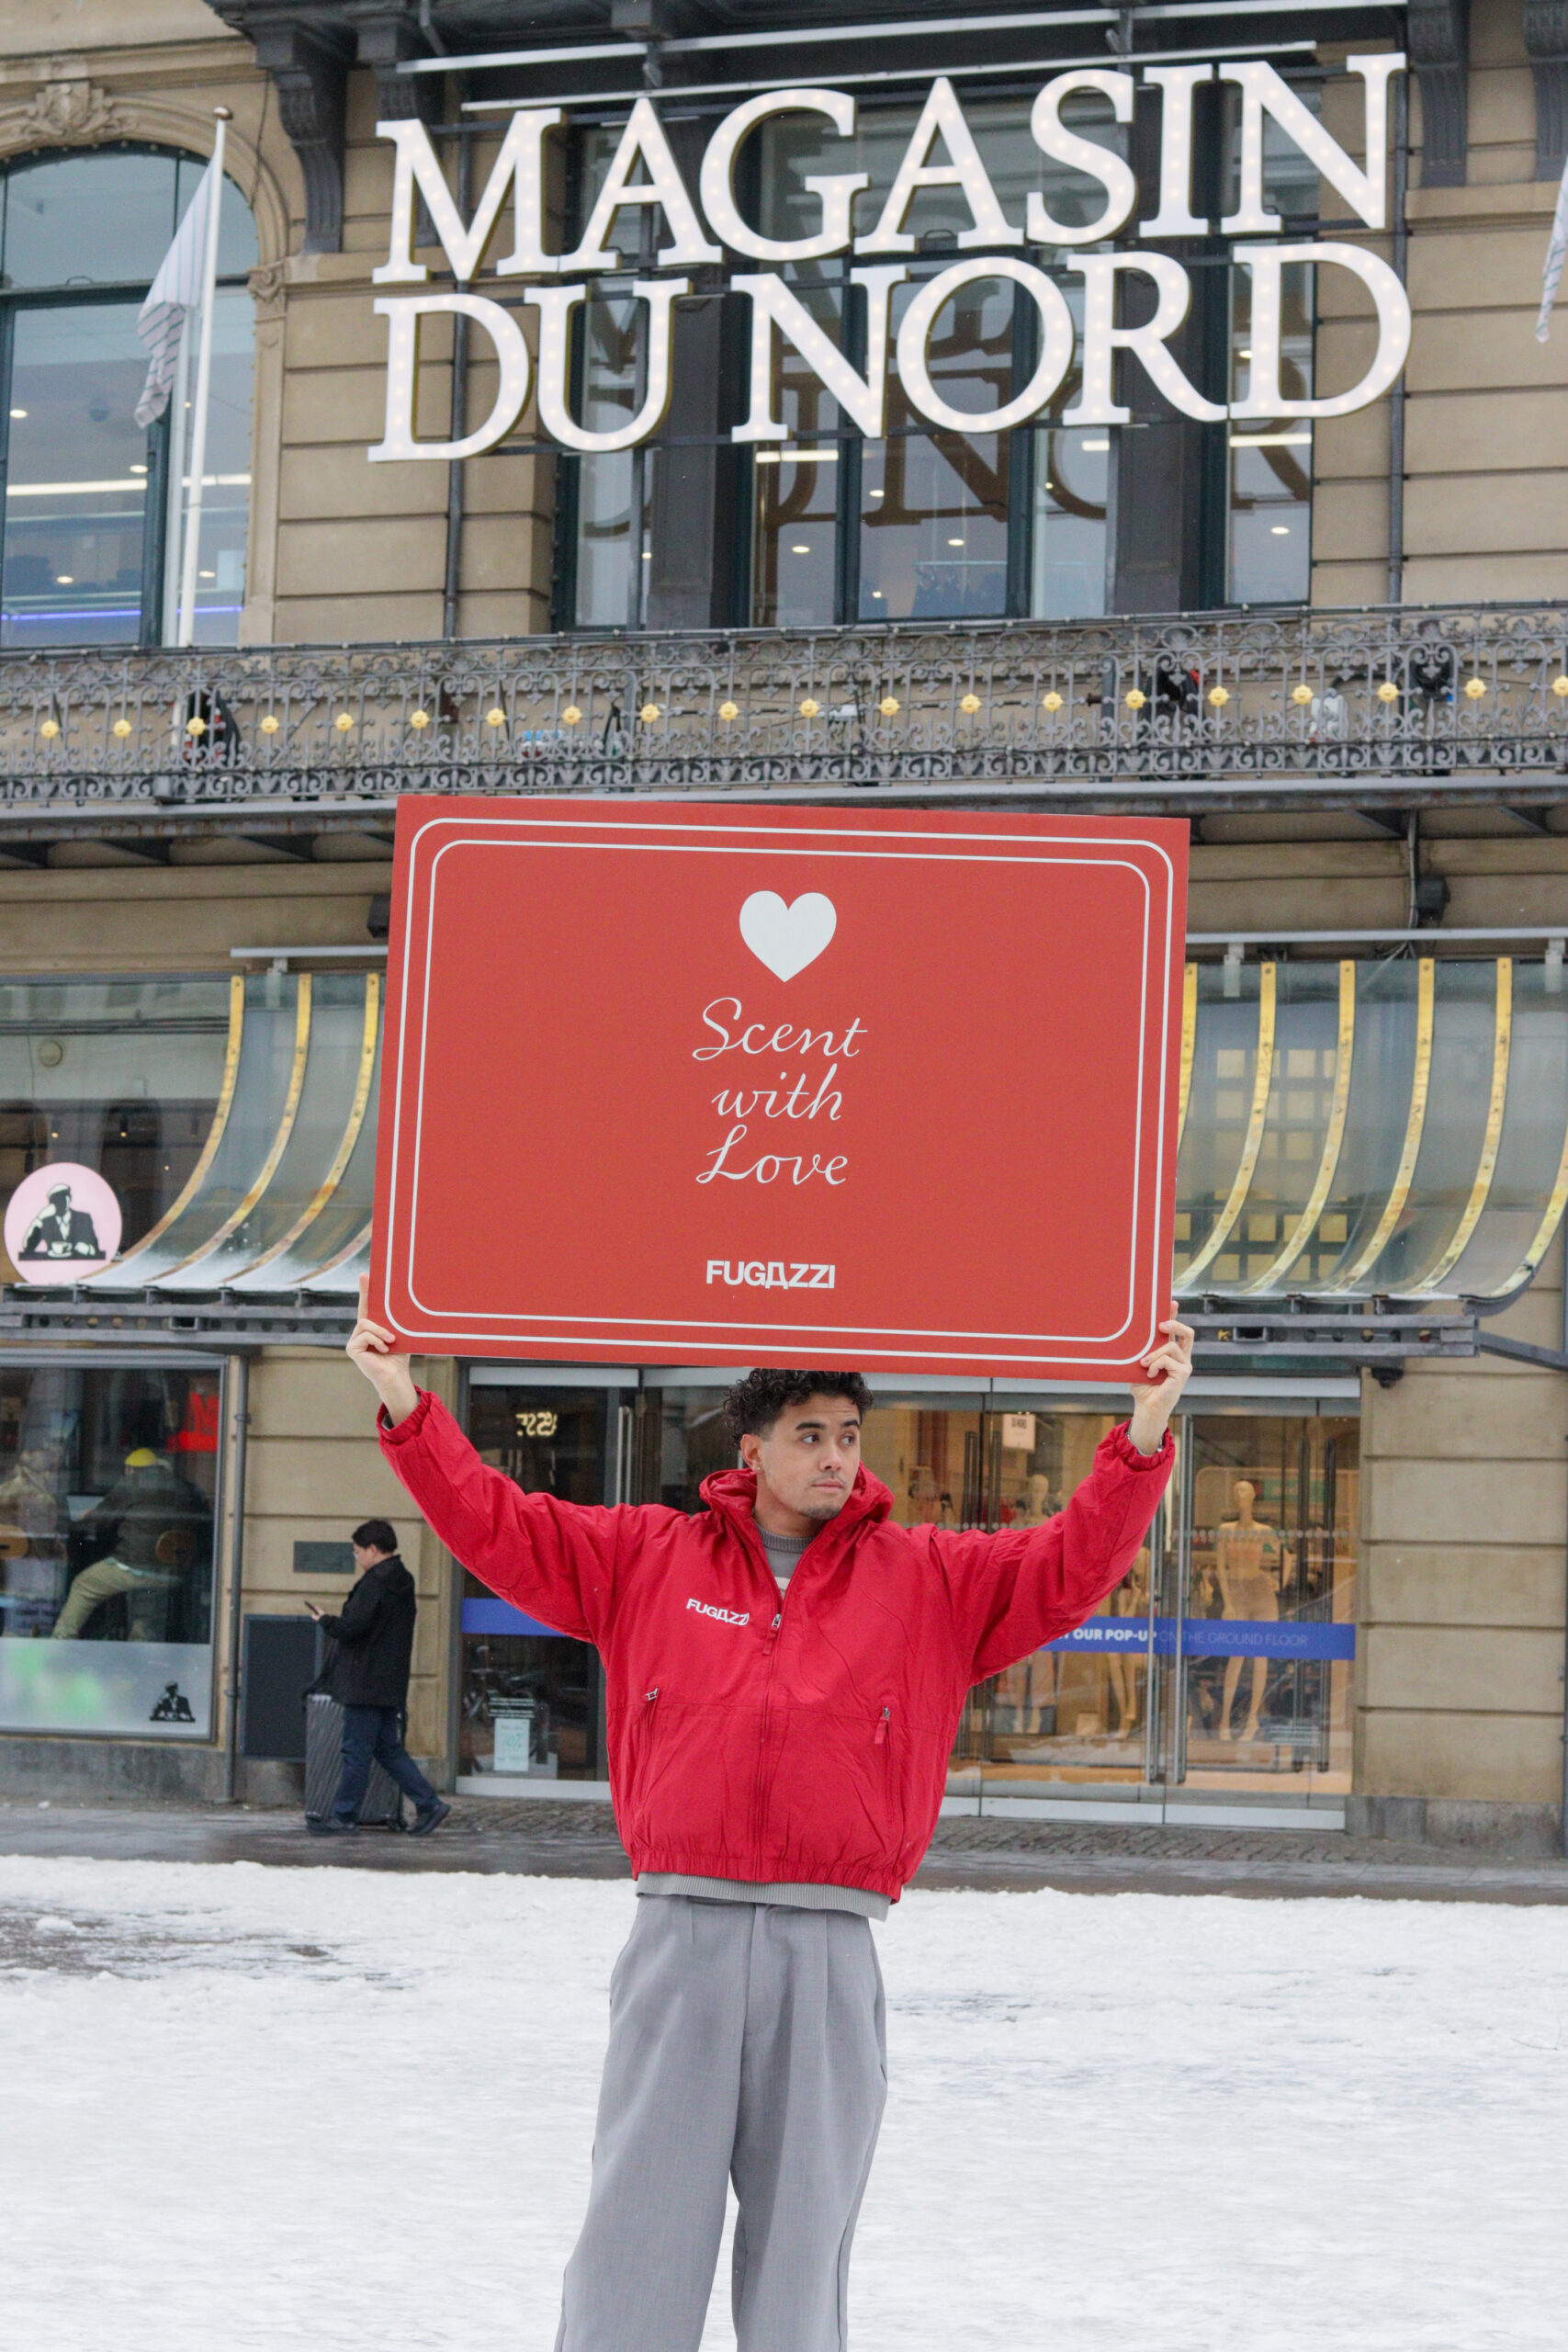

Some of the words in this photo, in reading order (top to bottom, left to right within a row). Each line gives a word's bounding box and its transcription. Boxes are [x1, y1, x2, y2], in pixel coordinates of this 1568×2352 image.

[372, 52, 1406, 284] MAGASIN
[367, 277, 692, 461] DU
[731, 242, 1413, 443] NORD
[693, 997, 867, 1061] Scent
[711, 1063, 842, 1121] with
[696, 1125, 849, 1186] Love
[1073, 1628, 1103, 1642] OUR
[1208, 1632, 1263, 1645] GROUND
[1266, 1634, 1308, 1647] FLOOR
